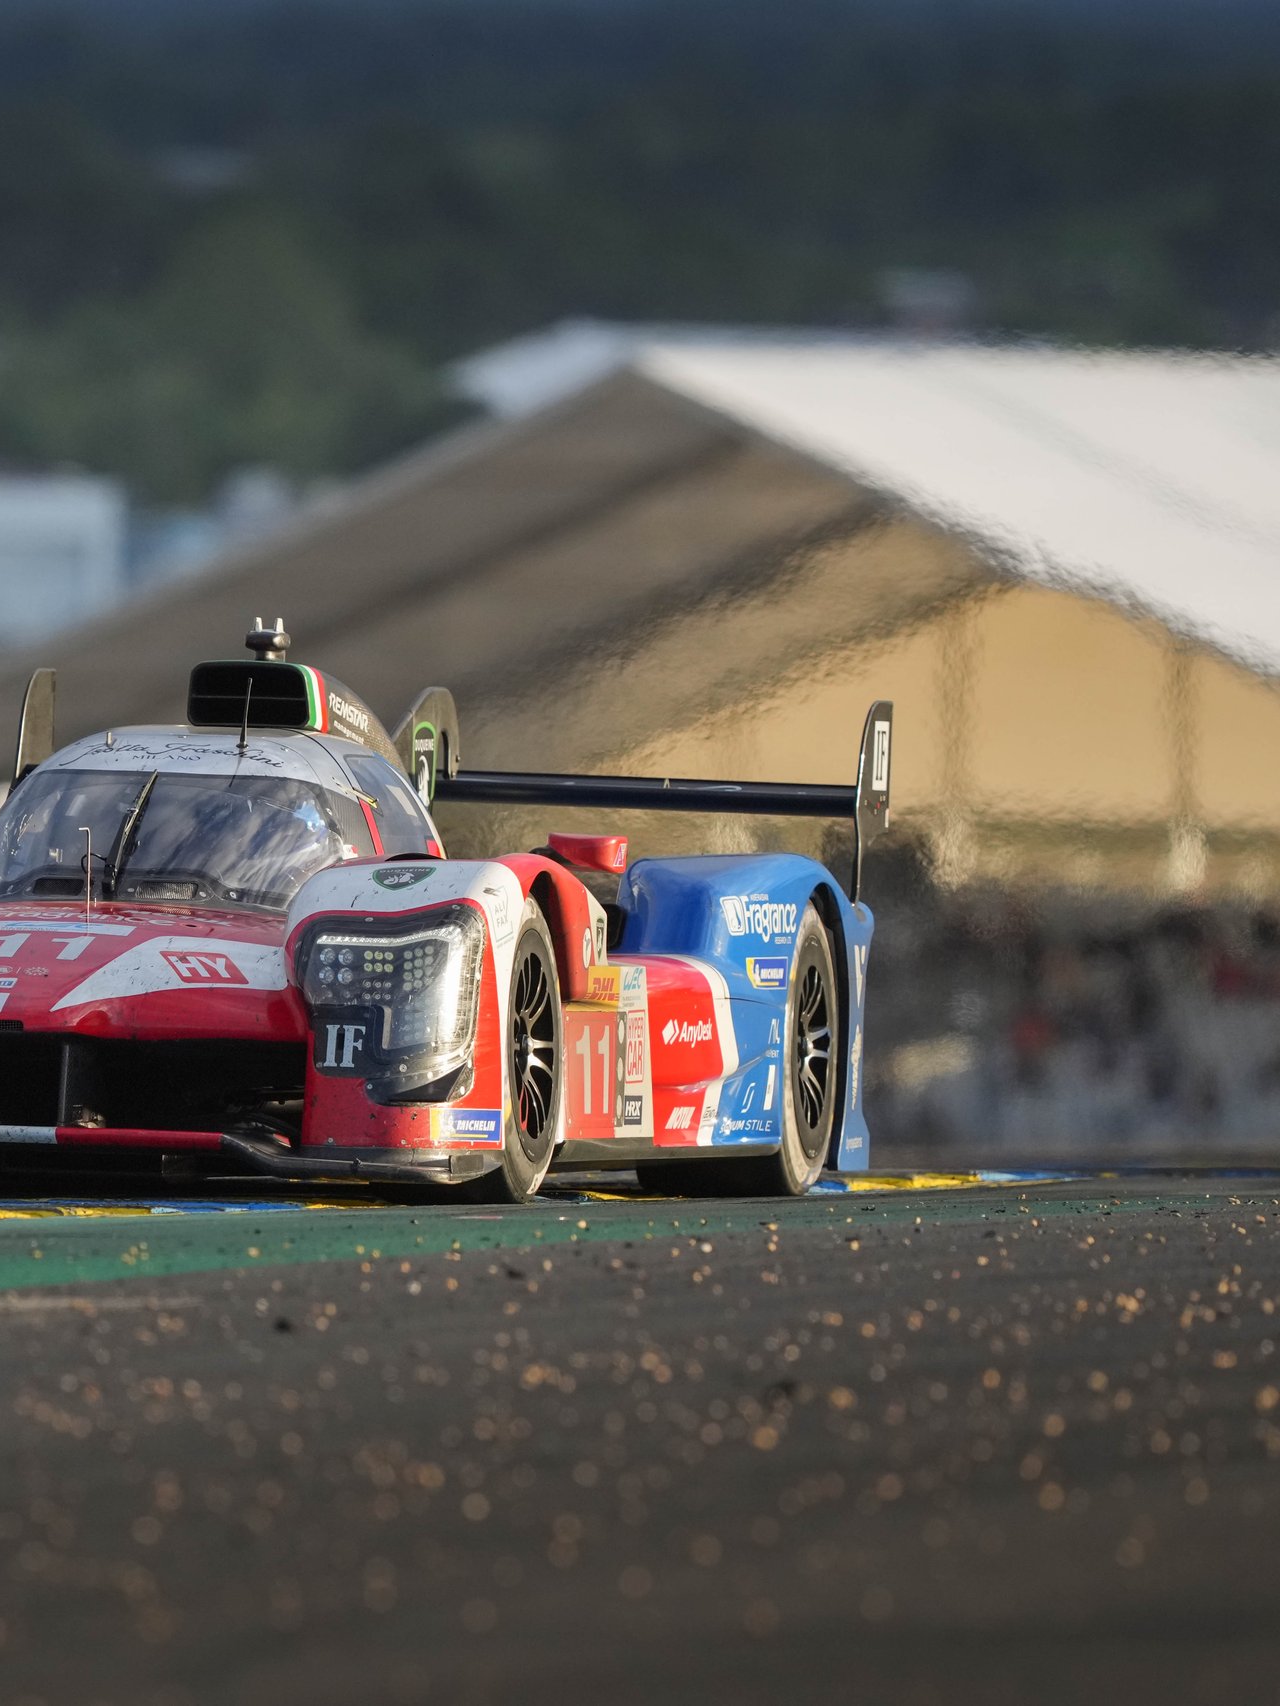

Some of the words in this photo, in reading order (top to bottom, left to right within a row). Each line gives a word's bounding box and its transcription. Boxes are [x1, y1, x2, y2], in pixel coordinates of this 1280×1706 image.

[328, 692, 369, 733] REMSTAR
[132, 754, 202, 762] MILANO
[740, 895, 797, 944] Fragrance
[168, 955, 232, 979] HY
[623, 967, 644, 991] WEC
[591, 977, 616, 1001] DHL
[627, 1016, 644, 1040] HYPER
[678, 1018, 713, 1049] AnyDesk
[323, 1024, 367, 1068] IF
[626, 1039, 643, 1077] CAR
[575, 1024, 611, 1115] 11
[624, 1100, 642, 1117] HRX
[664, 1106, 696, 1130] MOTUL
[456, 1119, 496, 1132] MICHELIN
[744, 1119, 773, 1132] STILE
